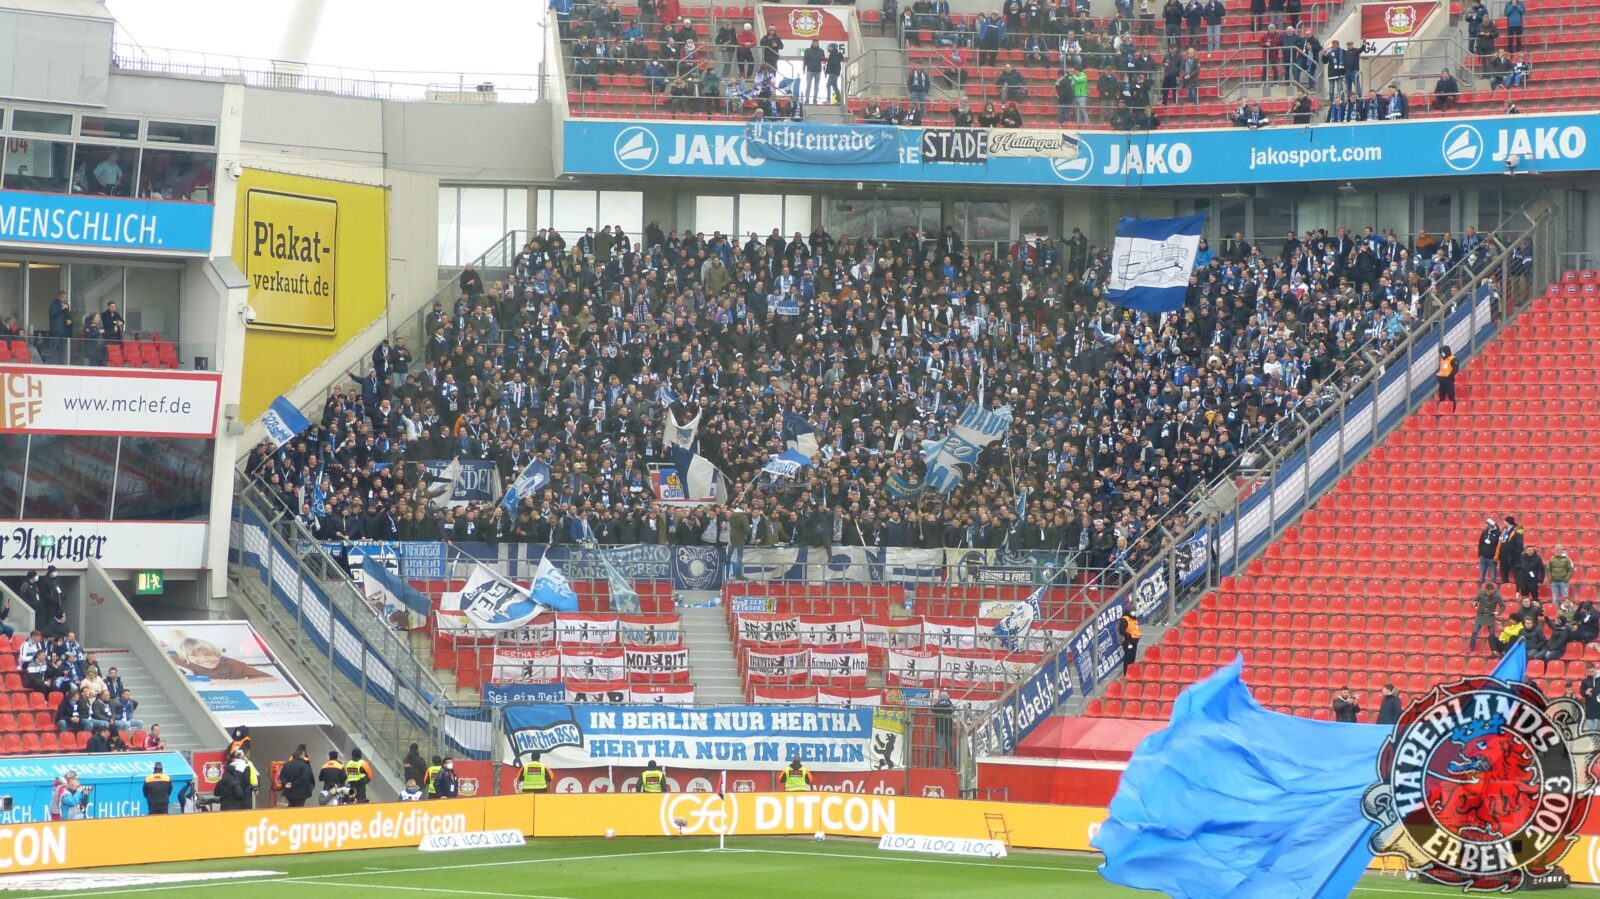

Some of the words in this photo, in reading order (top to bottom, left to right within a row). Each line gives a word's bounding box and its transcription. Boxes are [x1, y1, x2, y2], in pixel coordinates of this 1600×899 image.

[751, 124, 877, 152] Lichtenrade
[925, 130, 987, 160] STADE
[1492, 126, 1587, 162] JAKO
[1104, 142, 1192, 175] JAKO
[1250, 144, 1382, 170] jakosport.com
[0, 206, 164, 245] MENSCHLICH.
[254, 221, 331, 265] Plakat-
[253, 270, 329, 297] verkauft.de
[64, 394, 191, 416] www.mchef.de
[11, 527, 107, 563] Anzeiger
[1075, 624, 1094, 655] FAN
[1097, 604, 1123, 631] CLUB
[488, 691, 508, 703] Sei
[513, 692, 536, 702] ein
[537, 691, 565, 702] Teil
[589, 712, 616, 730] IN
[622, 711, 709, 731] BERLIN
[714, 711, 765, 731] NUR
[771, 712, 862, 732] HERTHA
[516, 724, 580, 751] HerthaBSC
[589, 739, 689, 760] HERTHA
[695, 741, 747, 761] NUR
[754, 741, 779, 762] IN
[785, 742, 865, 763] BERLIN
[755, 795, 896, 833] DITCON
[244, 809, 466, 855] gfc-gruppe.de/ditcon
[883, 836, 916, 850] iLOQ
[922, 838, 955, 853] iLOQ
